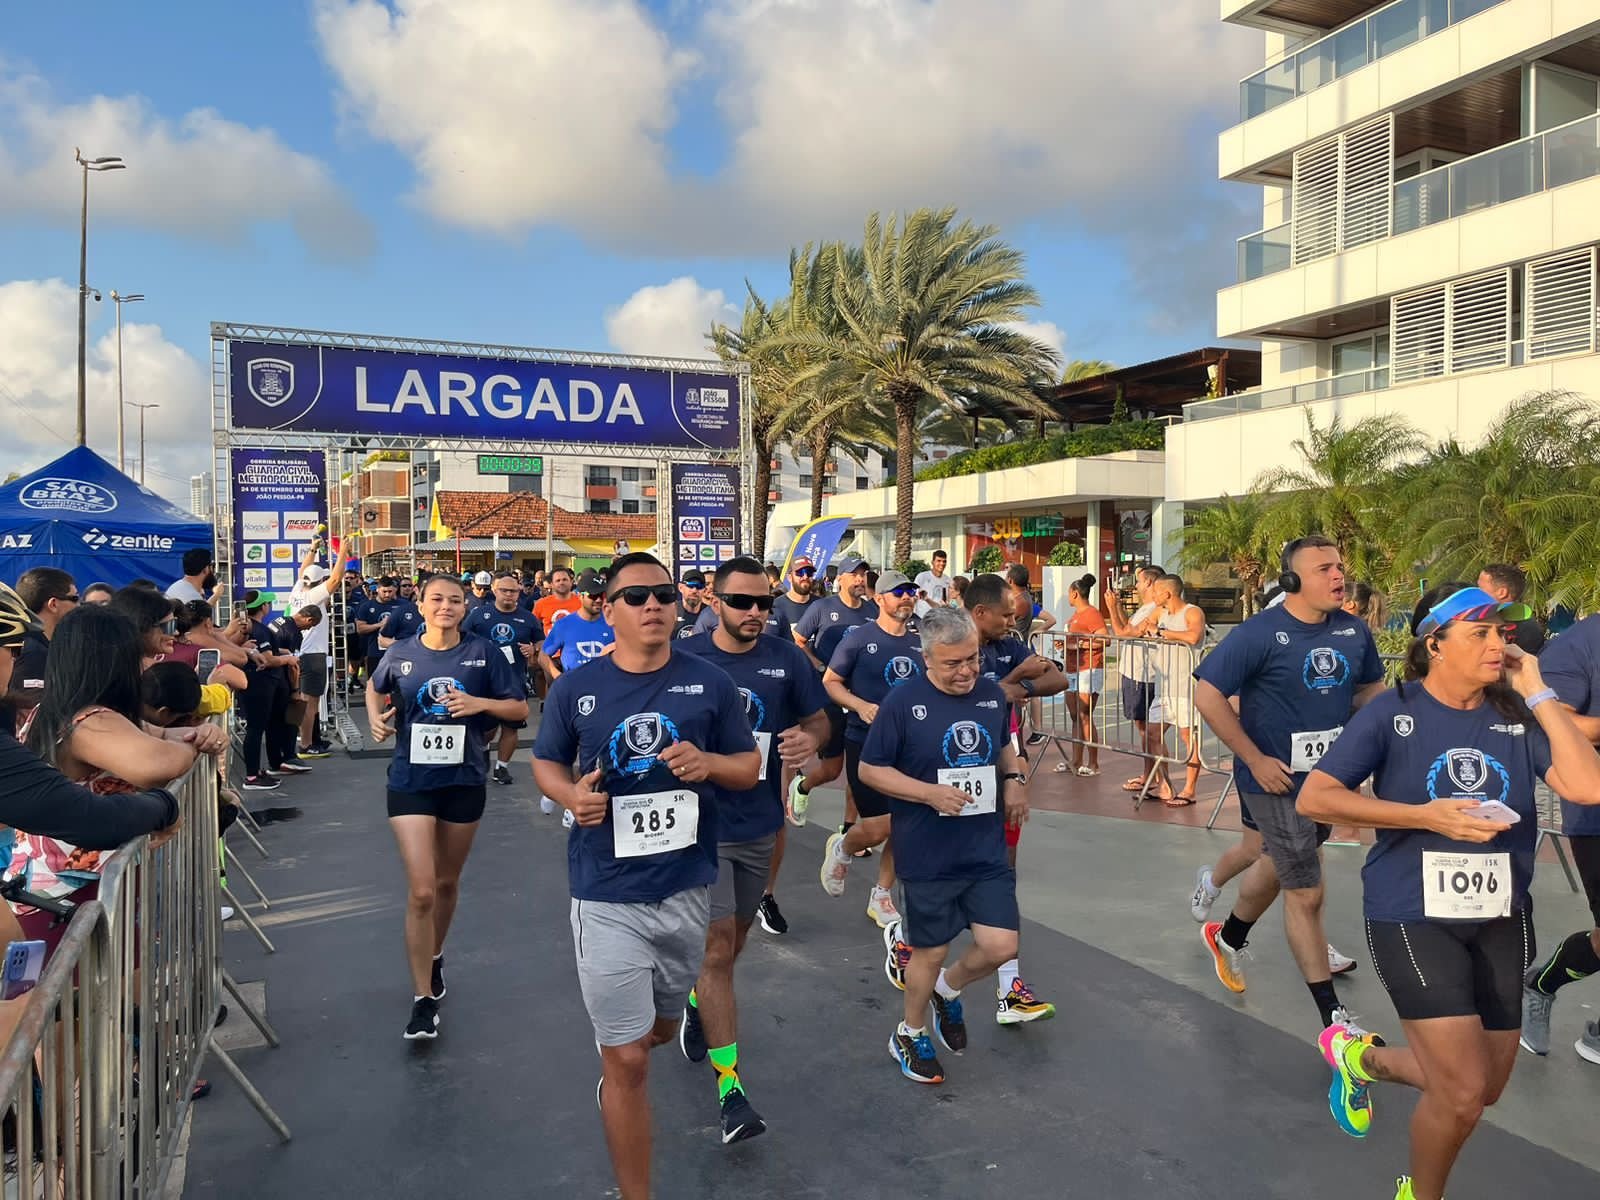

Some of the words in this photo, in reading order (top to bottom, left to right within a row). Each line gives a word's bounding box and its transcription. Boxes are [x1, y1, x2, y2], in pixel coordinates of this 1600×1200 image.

[355, 366, 645, 425] LARGADA
[246, 465, 286, 475] GUARDA
[287, 466, 312, 476] CIVIL
[480, 456, 541, 472] 00:00:39
[238, 473, 320, 484] METROPOLITANA
[46, 480, 97, 495] SÃO
[31, 490, 105, 504] BRAZ
[111, 534, 173, 549] zenite
[423, 736, 454, 749] 628
[1305, 742, 1335, 757] 29
[674, 794, 686, 802] 5K
[632, 808, 676, 834] 285
[1438, 870, 1498, 894] 1096
